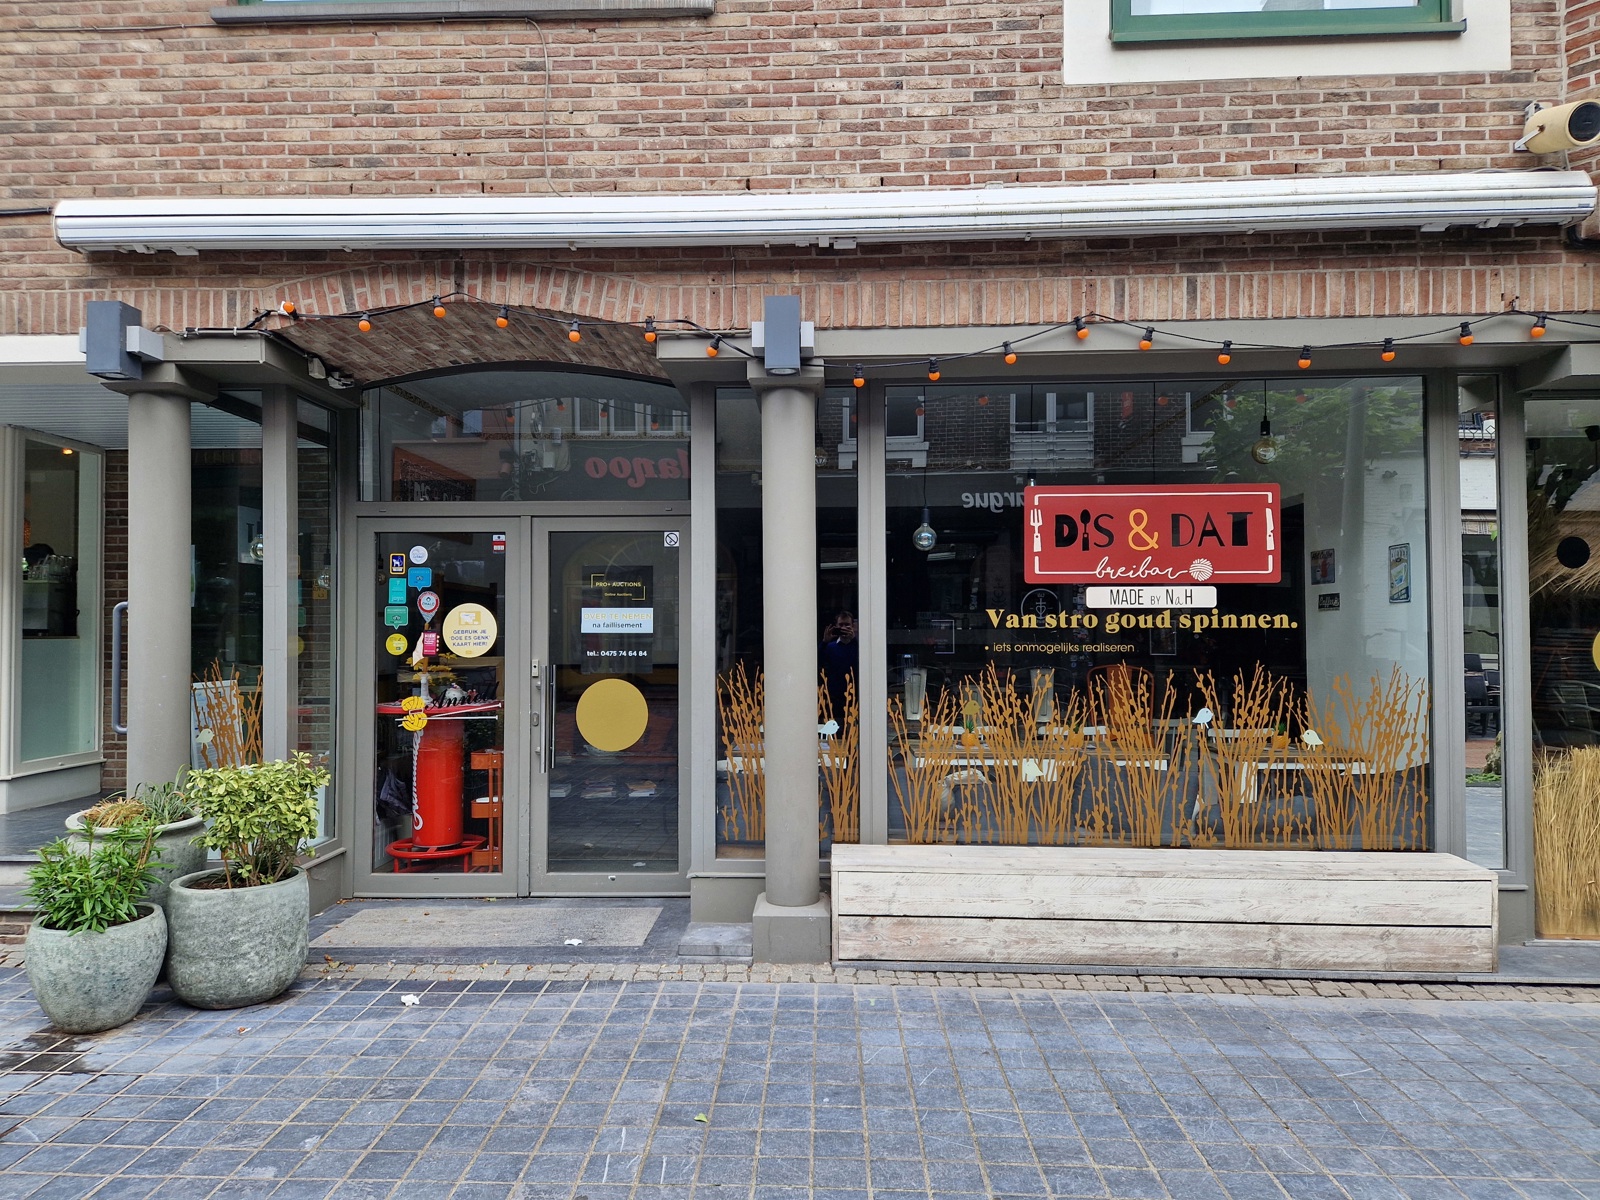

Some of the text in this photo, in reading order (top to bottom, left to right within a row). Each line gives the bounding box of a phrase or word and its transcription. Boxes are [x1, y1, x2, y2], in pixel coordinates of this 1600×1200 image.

[1128, 508, 1159, 551] &
[1171, 511, 1253, 548] DAT
[1095, 555, 1187, 579] breibar
[1109, 588, 1144, 605] MADE
[1150, 595, 1161, 605] BY
[985, 608, 1299, 633] Van stro goud spinnen.
[993, 642, 1135, 654] iets onmogelijks realiseren
